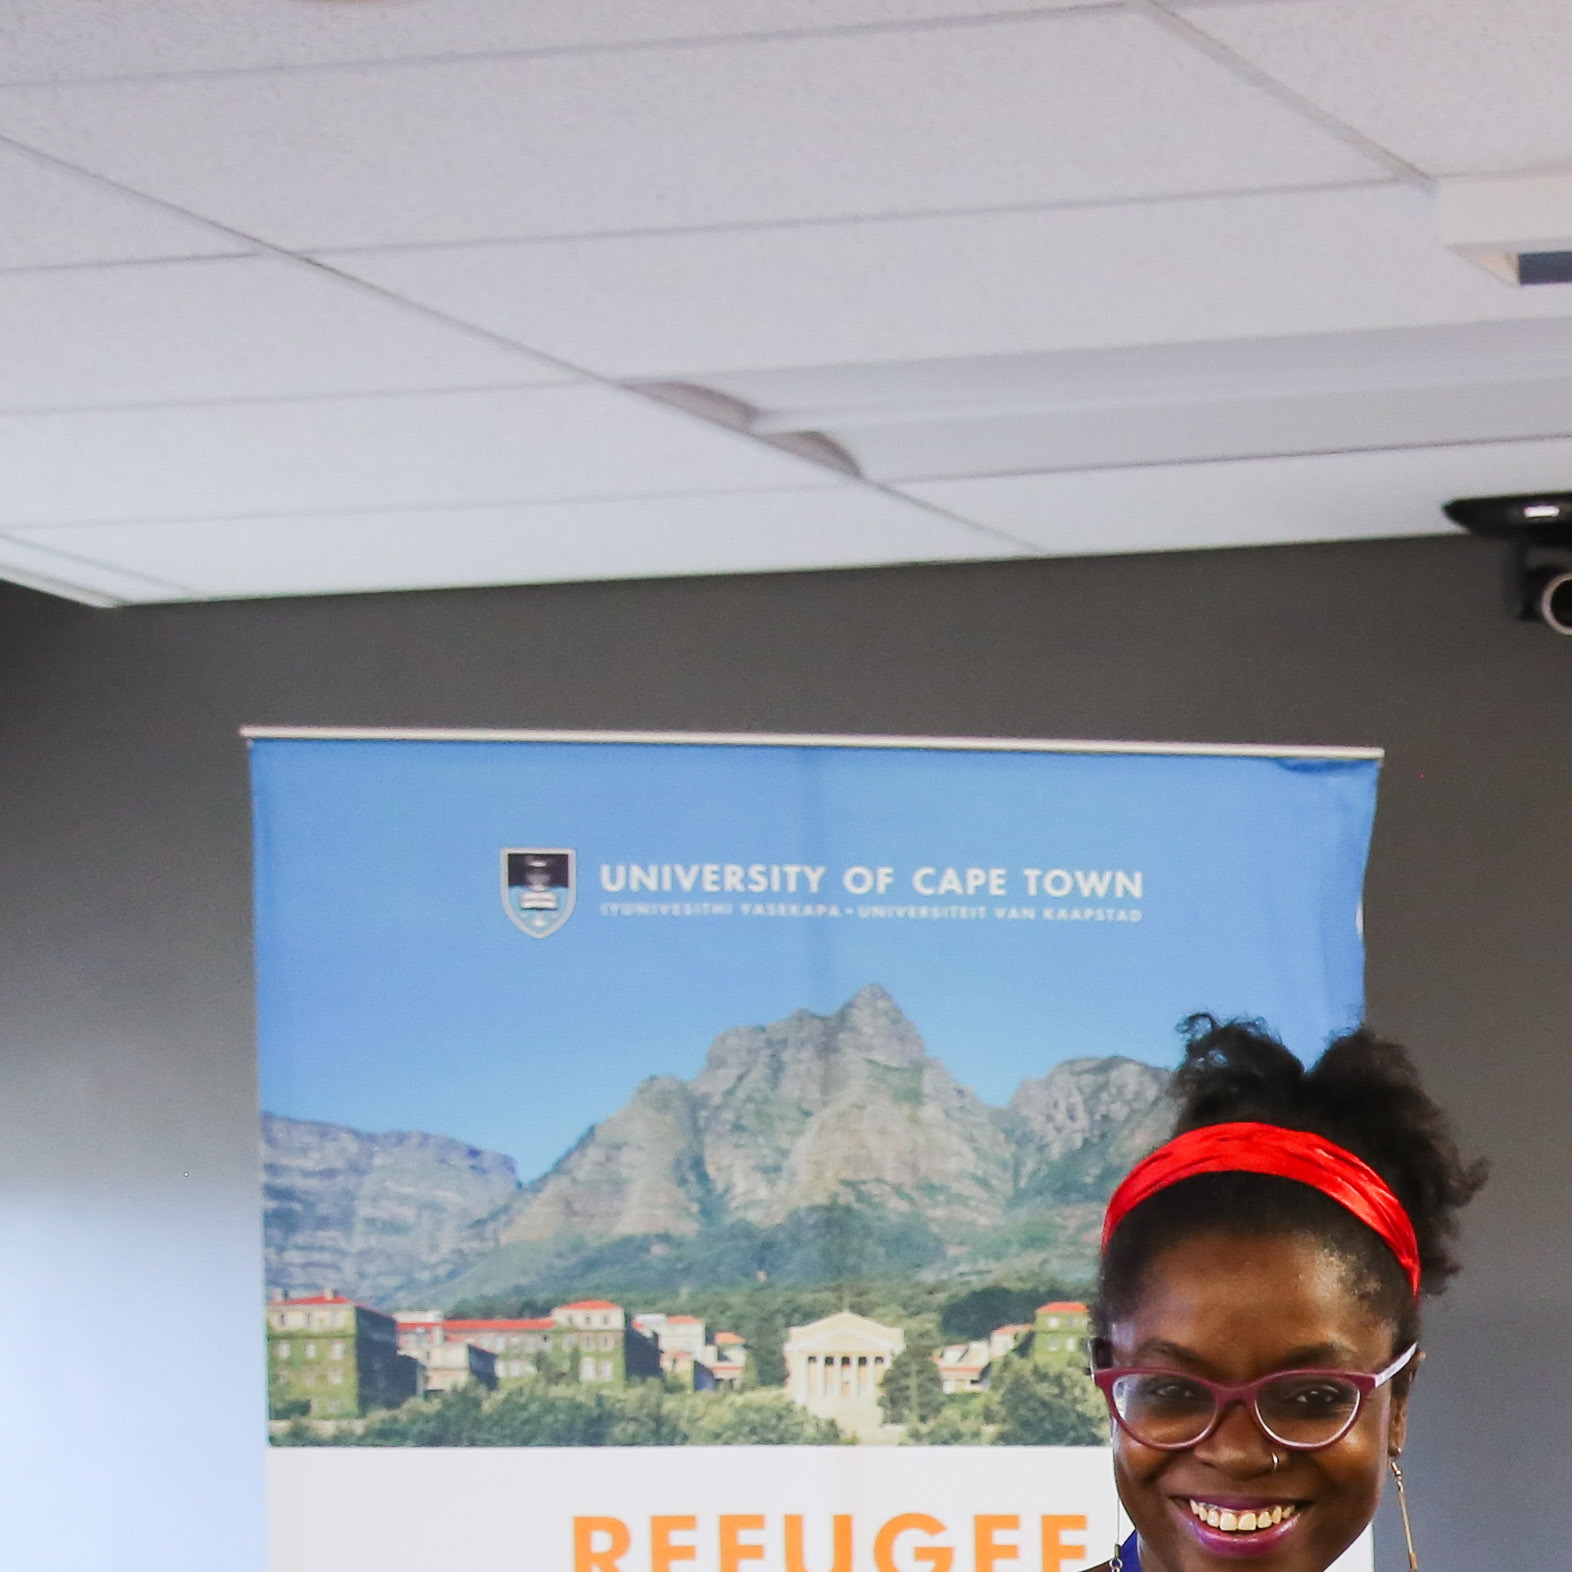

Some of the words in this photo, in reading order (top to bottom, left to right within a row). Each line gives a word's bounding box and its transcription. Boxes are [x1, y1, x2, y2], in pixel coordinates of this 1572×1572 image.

[600, 862, 827, 893] UNIVERSITY
[842, 865, 895, 895] OF
[911, 866, 1008, 897] CAPE
[1023, 868, 1144, 899] TOWN
[995, 906, 1036, 921] VAN
[1042, 907, 1144, 923] KAAPSTAD
